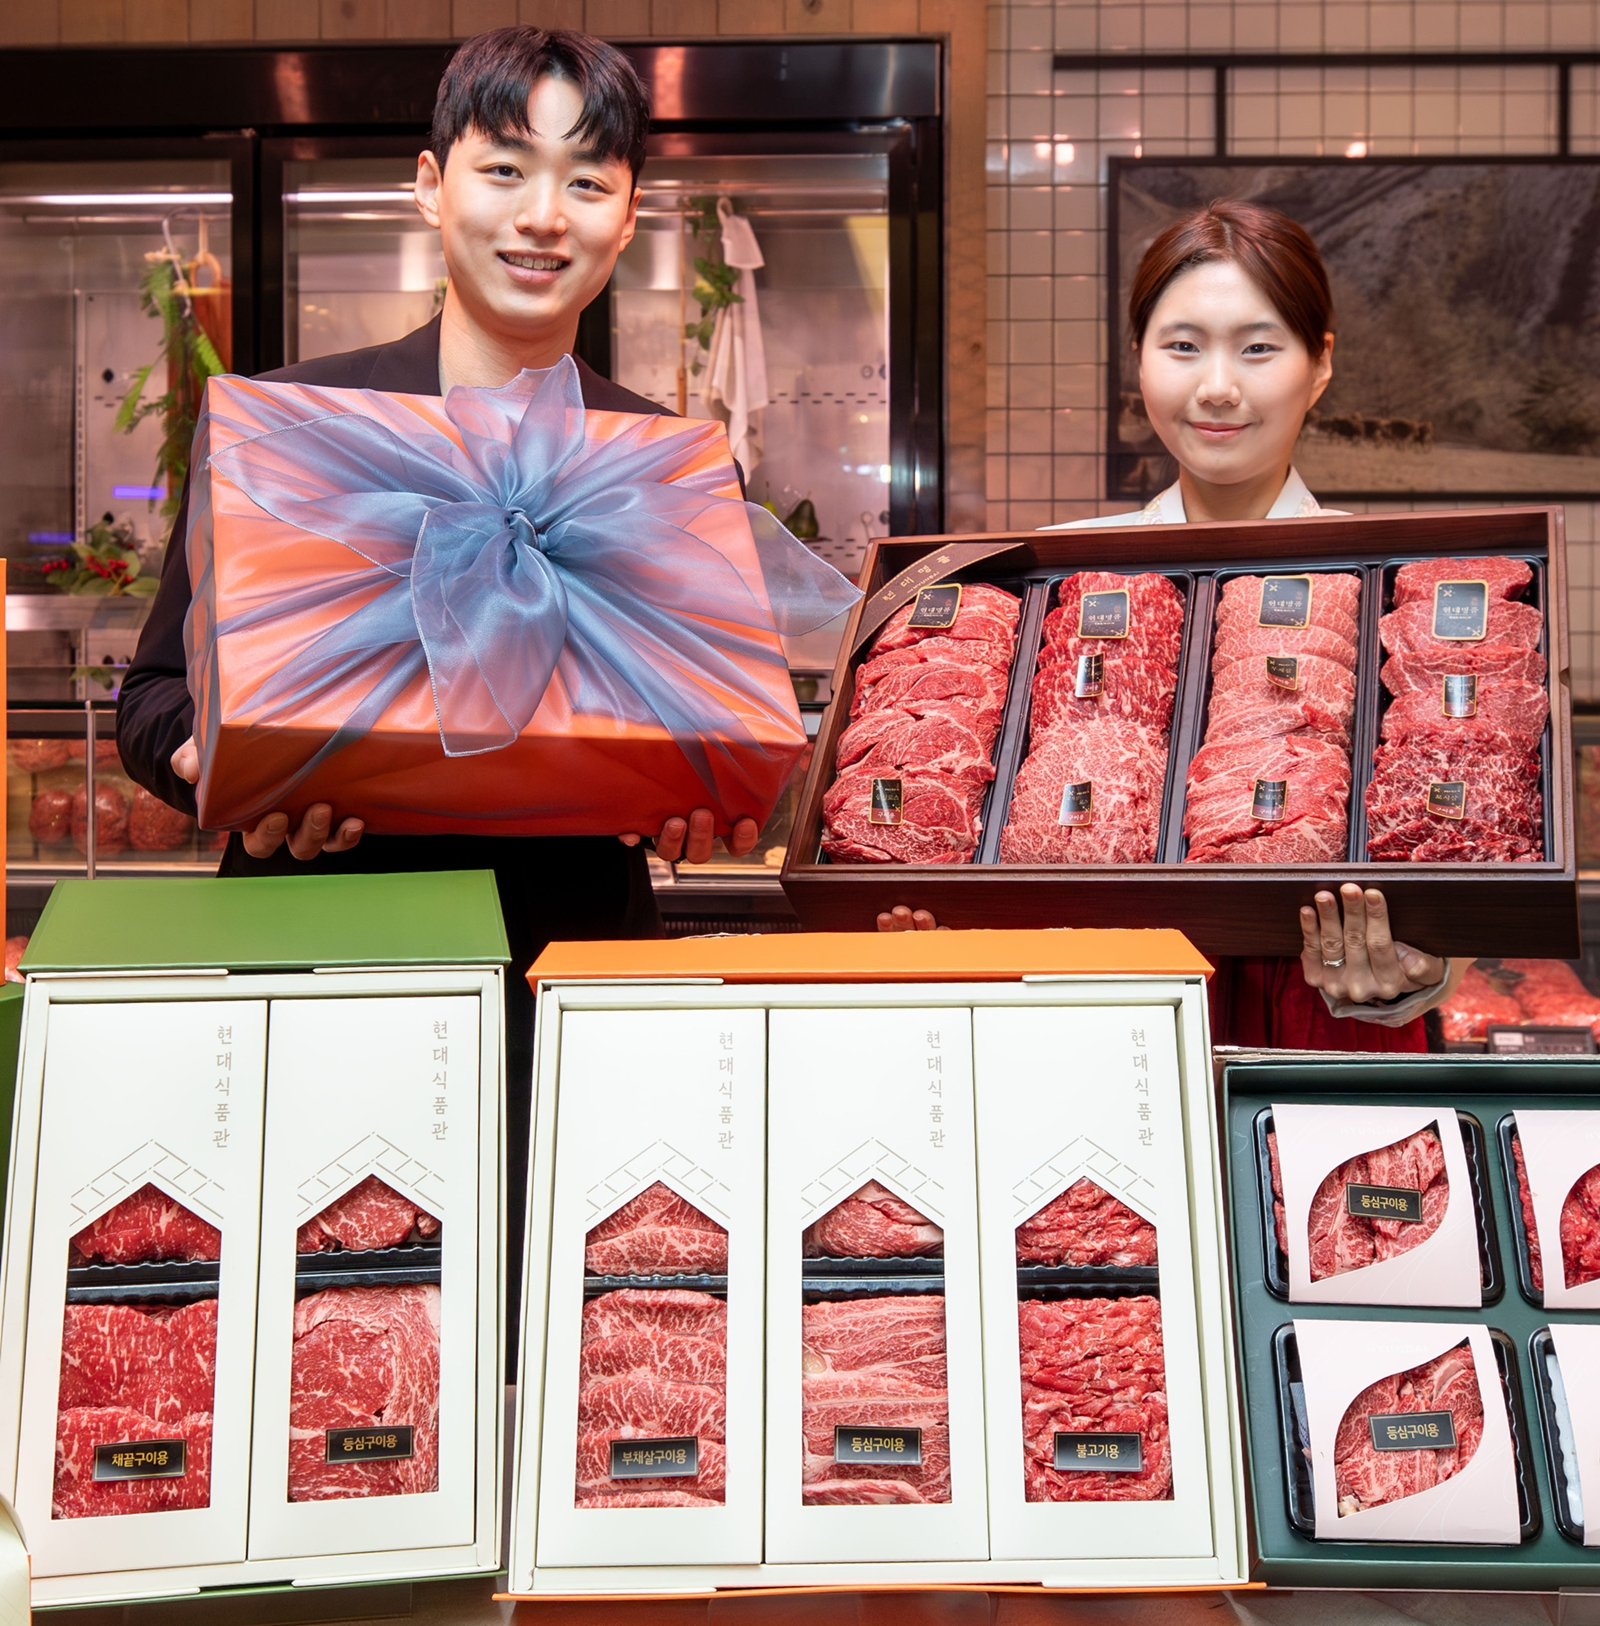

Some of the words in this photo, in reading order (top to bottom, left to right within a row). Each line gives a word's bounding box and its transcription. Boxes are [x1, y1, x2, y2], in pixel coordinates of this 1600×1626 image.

[212, 1025, 233, 1149] 현대식품관
[431, 1020, 449, 1141] 현대식품관
[926, 1030, 946, 1148] 현대식품관
[1131, 1028, 1155, 1147] 현대식품관
[717, 1031, 735, 1150] 현대식품관
[1339, 1125, 1400, 1136] HYUNDAI
[1360, 1194, 1409, 1212] 등심구이용
[1386, 1422, 1440, 1441] 등심구이용
[342, 1434, 398, 1452] 등심구이용
[850, 1437, 906, 1453] 등심구이용
[1075, 1443, 1120, 1460] 불고기용
[111, 1450, 169, 1468] 채끝구이용
[621, 1448, 687, 1466] 부채살구이용
